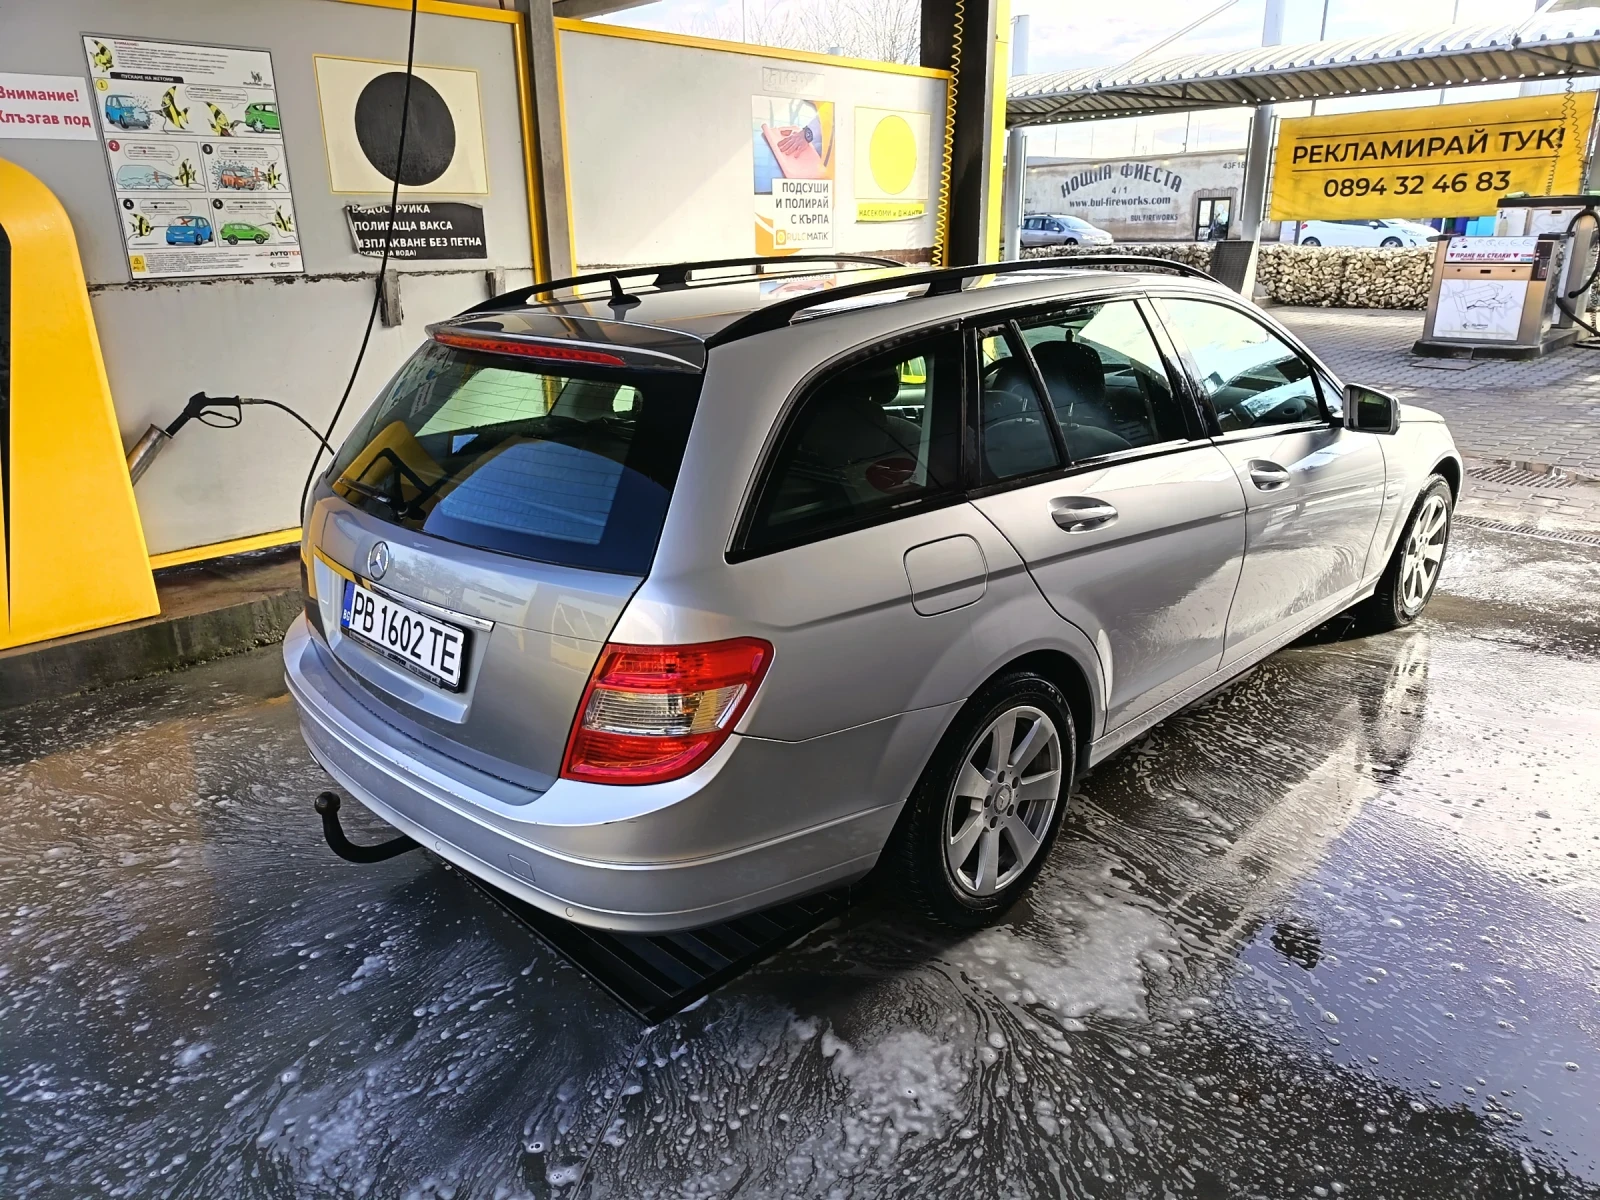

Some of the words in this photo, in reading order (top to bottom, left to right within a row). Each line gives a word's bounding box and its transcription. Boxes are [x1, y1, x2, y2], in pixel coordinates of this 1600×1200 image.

[0, 86, 79, 102] Внимание!
[64, 115, 91, 128] под
[110, 140, 117, 150] 2
[1292, 129, 1487, 165] РЕКЛАМИРАЙ
[1499, 126, 1566, 153] ТУК!
[1120, 162, 1183, 193] ФИЕСТА
[1323, 177, 1387, 198] 0894
[1393, 175, 1424, 196] 32
[1432, 172, 1468, 195] 46
[1475, 170, 1512, 193] 83
[782, 182, 829, 195] ПОДСУШИ
[125, 199, 132, 209] 4
[215, 199, 221, 208] 5
[775, 199, 783, 209] И
[785, 196, 829, 209] ПОЛИРАЙ
[1069, 196, 1171, 208] www.bul-fireworks.com
[790, 214, 797, 225] С
[799, 214, 829, 225] КЪРПА
[1130, 214, 1144, 222] BUL
[1145, 213, 1178, 222] FIREWORKS
[419, 220, 454, 231] ВАКСА
[429, 238, 448, 247] БЕЗ
[450, 237, 482, 246] ПЕТНА
[342, 609, 352, 622] BG
[352, 591, 375, 633] PB
[380, 605, 424, 660] 1602
[429, 626, 458, 676] TE
